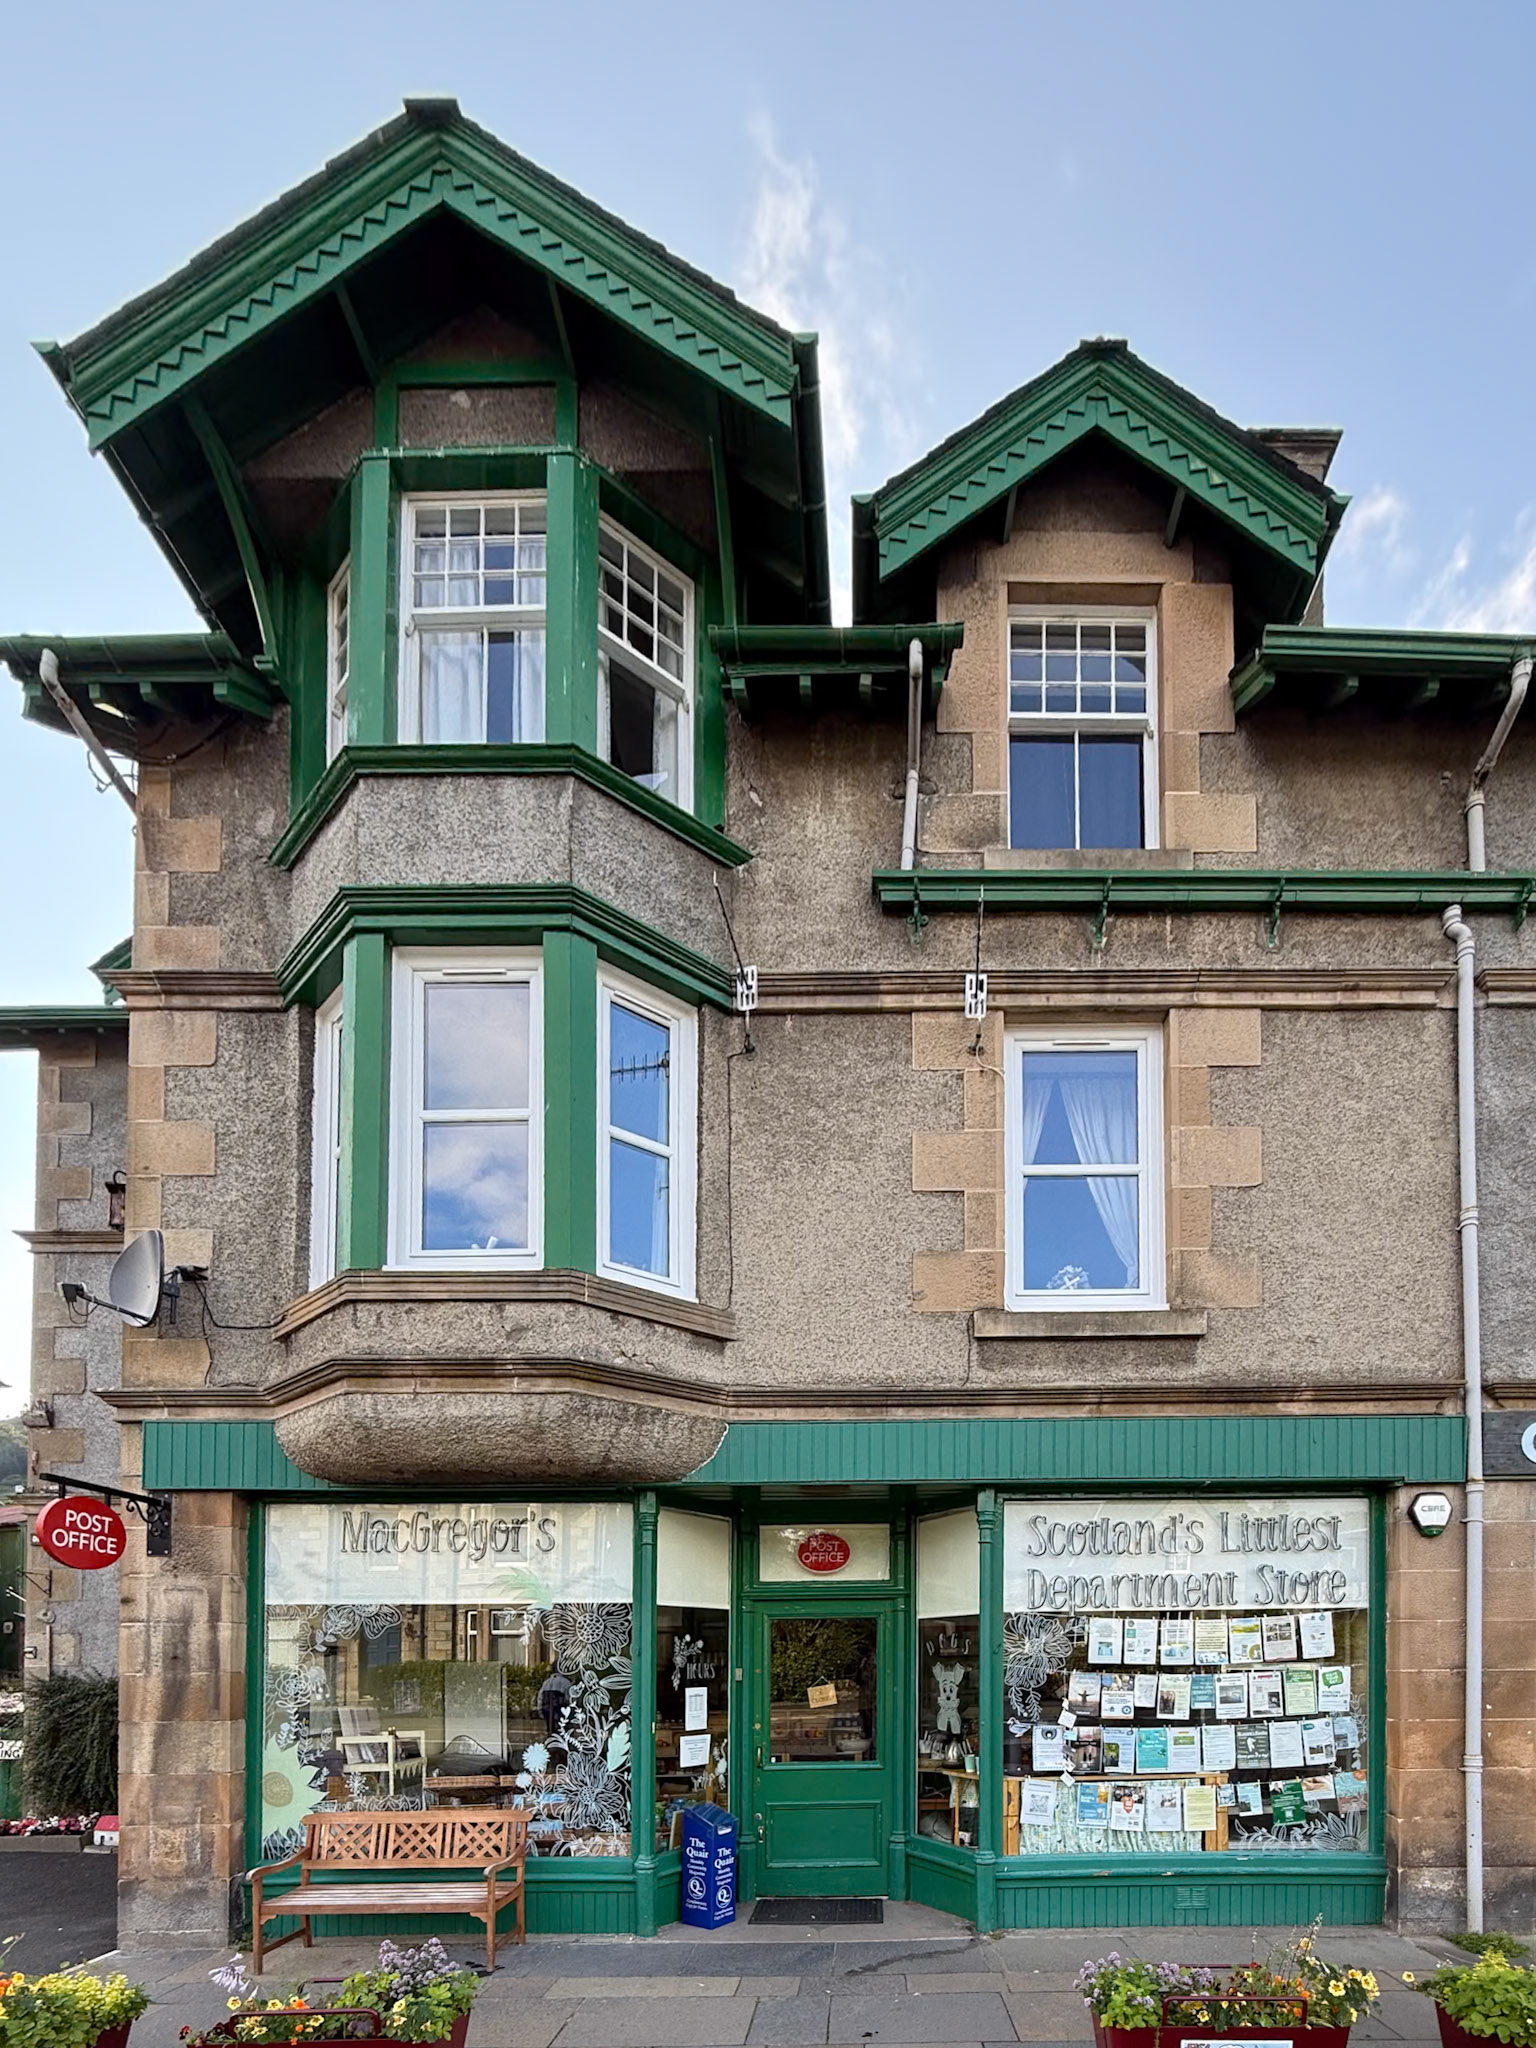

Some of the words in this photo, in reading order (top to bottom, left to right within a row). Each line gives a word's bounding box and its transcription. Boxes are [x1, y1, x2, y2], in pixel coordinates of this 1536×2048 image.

[65, 1509, 113, 1534] POST
[52, 1528, 117, 1554] OFFICE
[341, 1510, 556, 1561] MacGregor's
[1027, 1513, 1204, 1556] Scotland's
[1219, 1511, 1342, 1553] Littlest
[809, 1540, 838, 1551] POST
[802, 1551, 844, 1563] OFFICE
[1027, 1568, 1238, 1613] Department
[1254, 1563, 1347, 1605] Store
[686, 1662, 715, 1680] HOURS
[689, 1837, 706, 1848] The
[686, 1846, 709, 1859] Quair
[717, 1847, 732, 1857] The
[714, 1855, 735, 1869] Quair
